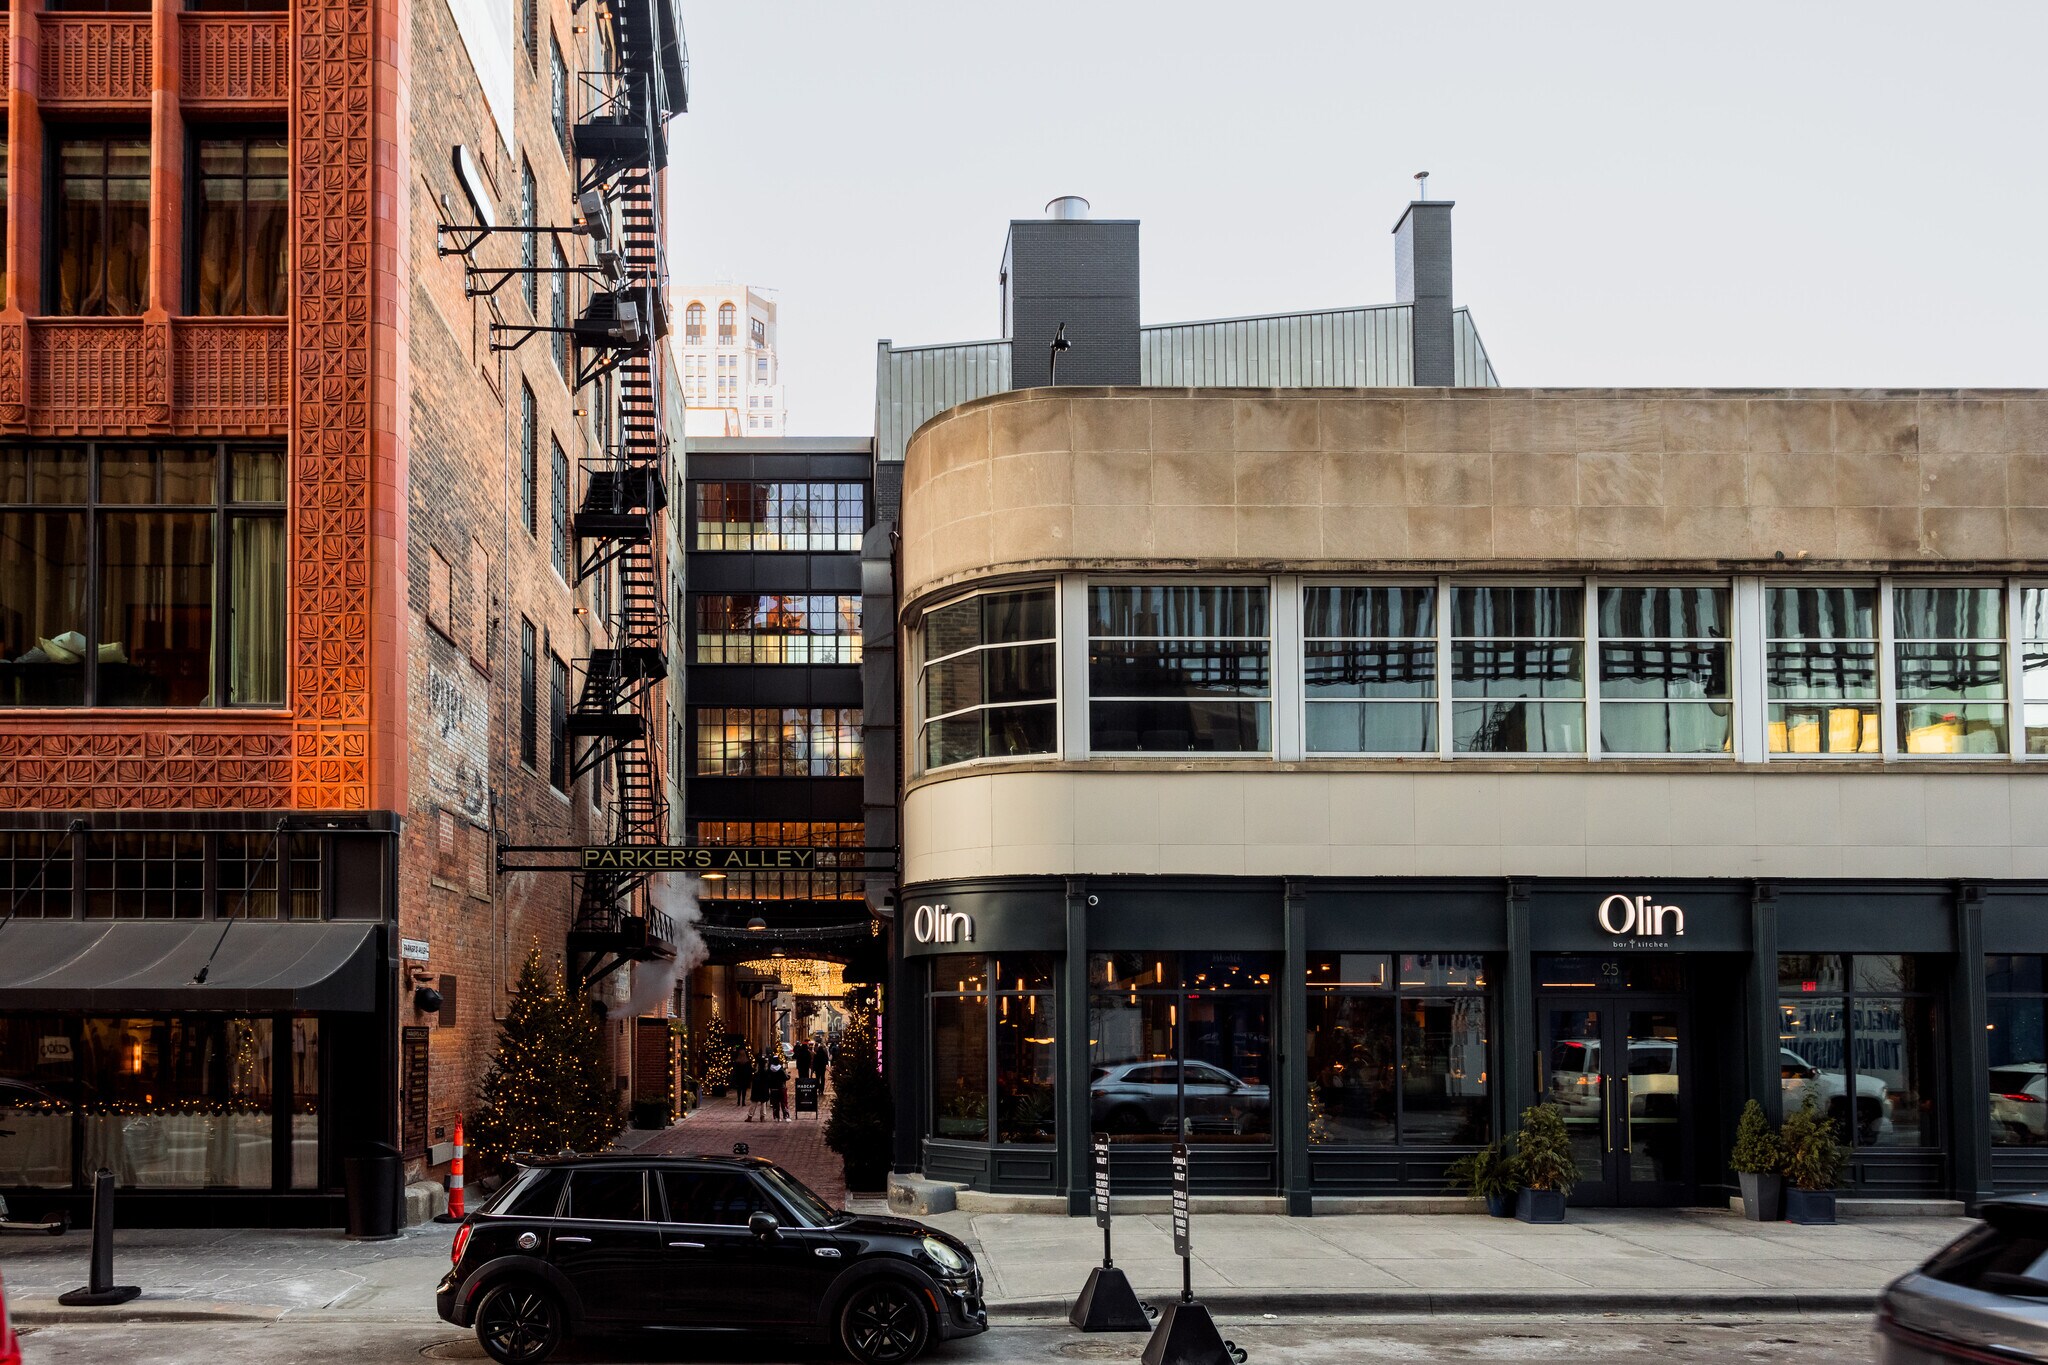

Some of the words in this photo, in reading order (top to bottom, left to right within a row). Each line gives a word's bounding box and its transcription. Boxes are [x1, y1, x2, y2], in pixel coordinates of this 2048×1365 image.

[584, 849, 711, 867] PARKER'S
[724, 850, 812, 867] ALLEY
[1598, 894, 1684, 936] Olin
[914, 904, 972, 943] Olin
[1601, 962, 1619, 976] 25
[1802, 981, 1817, 992] EXIT
[1097, 1157, 1107, 1165] VALET
[1174, 1173, 1185, 1181] VALET
